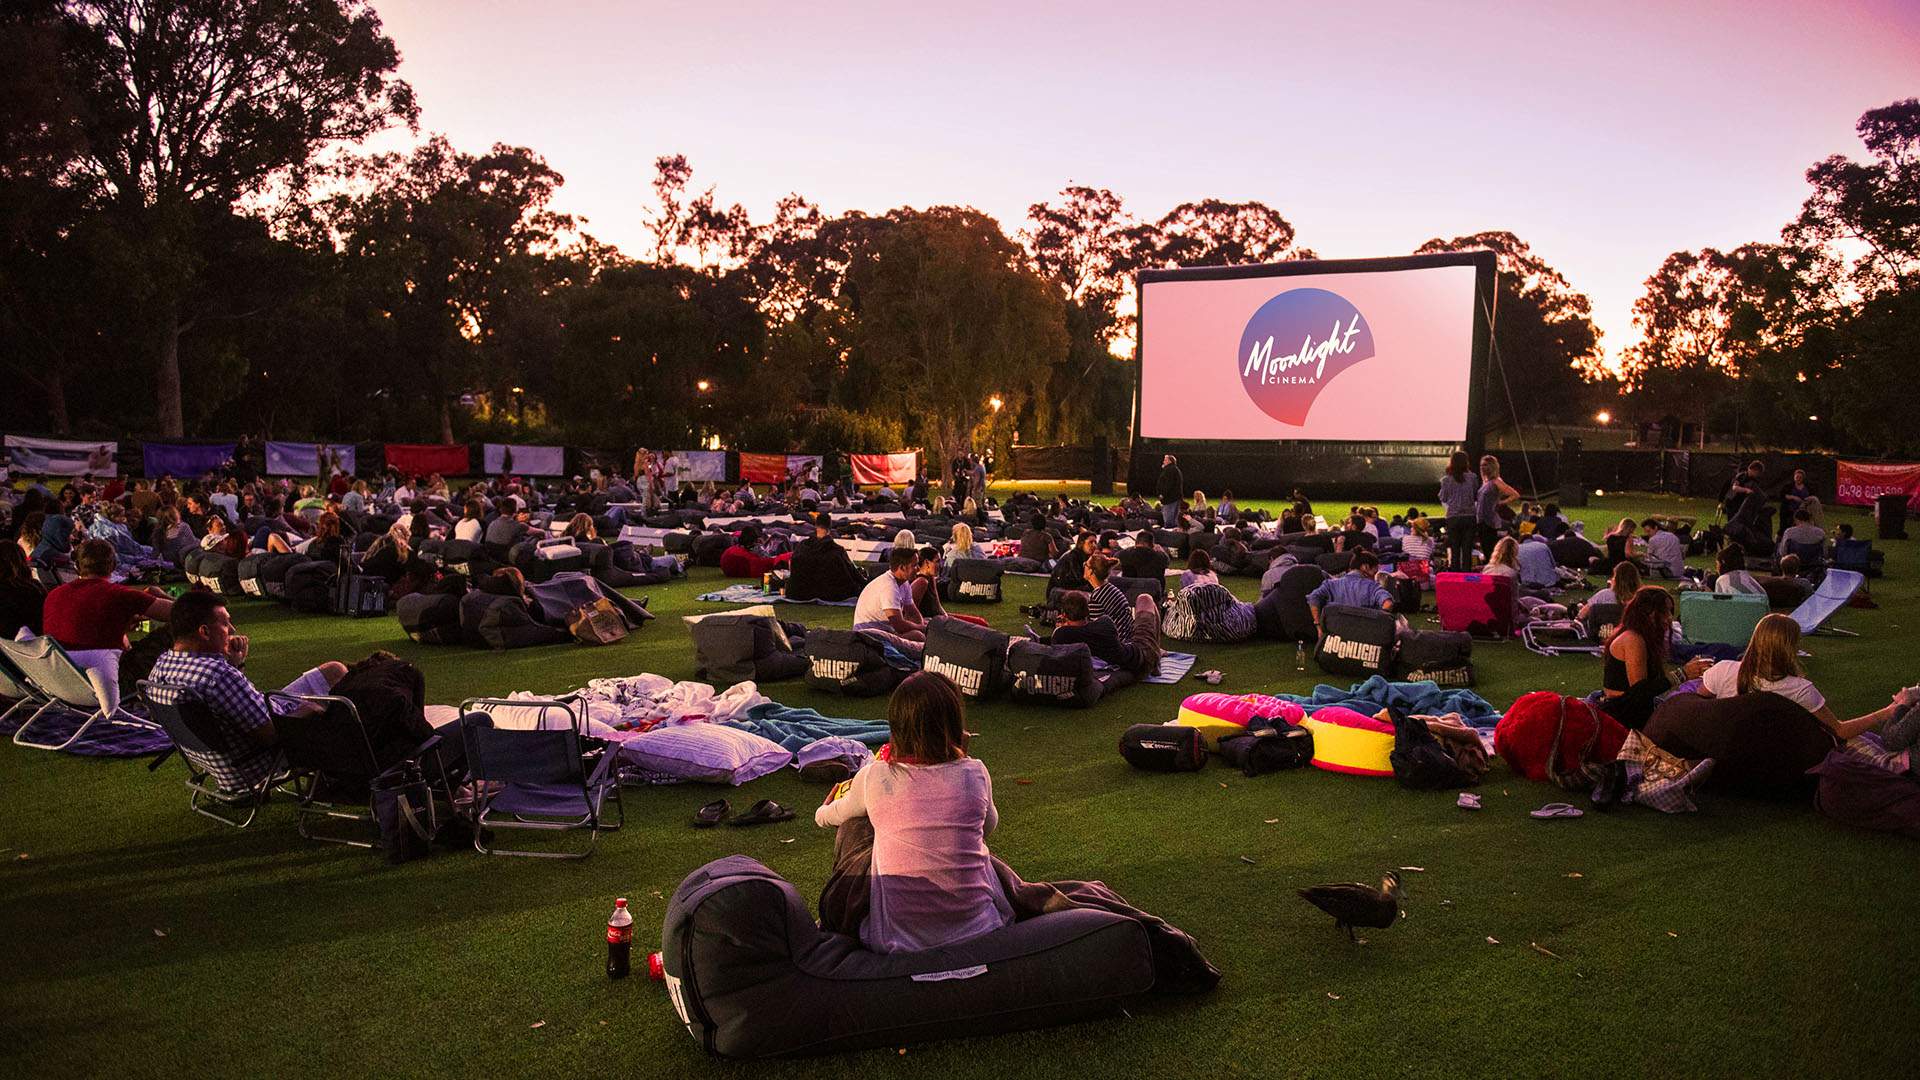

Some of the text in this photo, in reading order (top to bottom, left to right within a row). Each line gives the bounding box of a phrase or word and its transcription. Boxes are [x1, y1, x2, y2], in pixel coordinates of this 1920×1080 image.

[1244, 313, 1360, 385] Moonlight
[1839, 485, 1862, 498] 0498
[959, 581, 998, 596] MOONLIGHT
[1323, 635, 1382, 662] MOONLIGHT
[809, 655, 859, 680] ONLIGHT
[924, 655, 983, 689] MOONLIGHT
